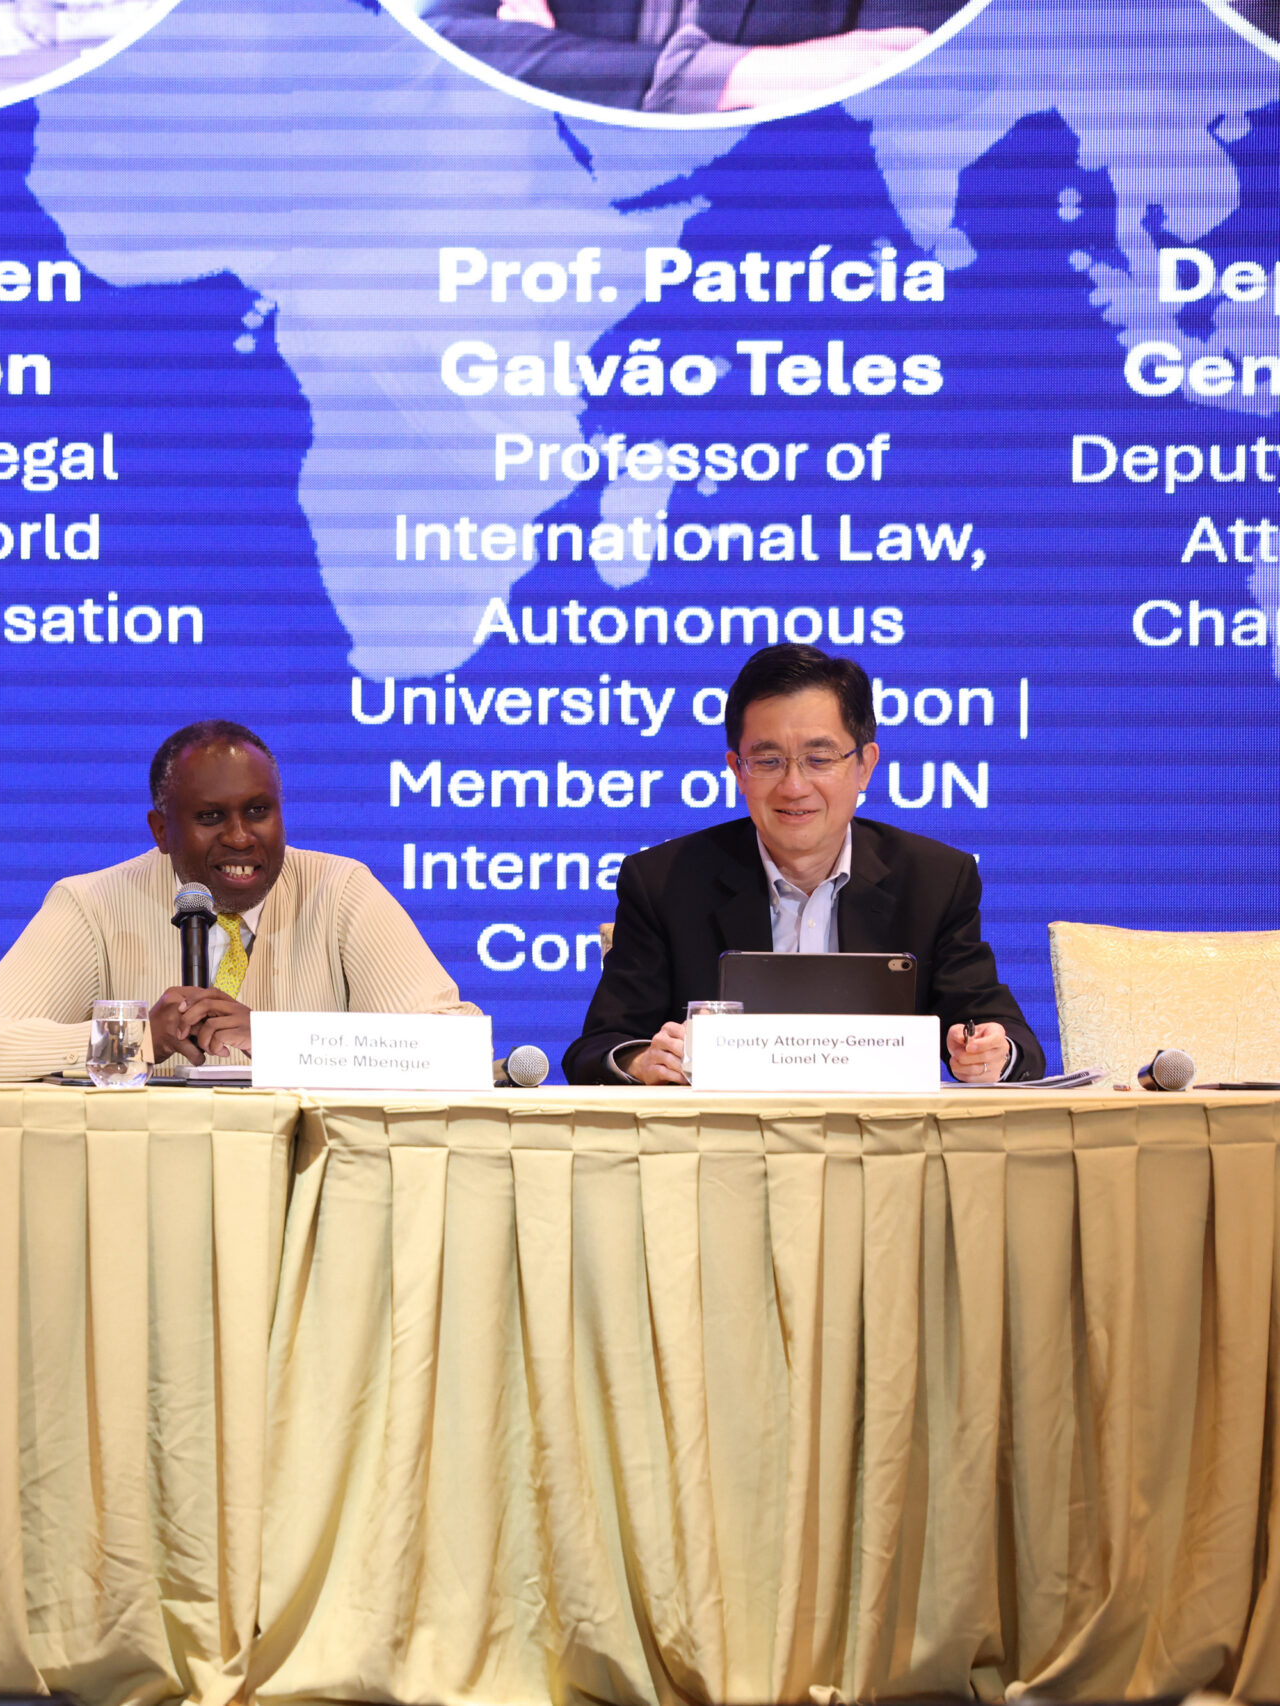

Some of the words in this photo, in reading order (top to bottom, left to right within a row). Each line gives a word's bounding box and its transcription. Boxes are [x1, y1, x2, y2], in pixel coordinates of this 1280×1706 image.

[437, 246, 619, 303] Prof.
[644, 245, 945, 302] Patrícia
[1159, 246, 1280, 318] De
[439, 338, 719, 397] Galvão
[736, 340, 943, 396] Teles
[1123, 340, 1280, 398] Gen
[493, 432, 808, 483] Professor
[826, 434, 890, 481] of
[1072, 435, 1280, 494] Deput
[395, 511, 819, 563] International
[840, 514, 986, 569] Law,
[1181, 516, 1279, 563] Att
[471, 597, 907, 647] Autonomous
[1132, 600, 1280, 647] Cha
[351, 674, 675, 737] University
[390, 761, 663, 808] Member
[889, 762, 988, 809] UN
[402, 838, 671, 891] Interna
[298, 1054, 348, 1067] Moise
[353, 1055, 431, 1072] Mbengue
[310, 1034, 349, 1047] Prof.
[354, 1035, 419, 1049] Makane
[716, 1035, 769, 1049] Deputy
[774, 1035, 905, 1049] Attorney-General
[771, 1053, 817, 1065] Lionel
[821, 1053, 849, 1064] Yee
